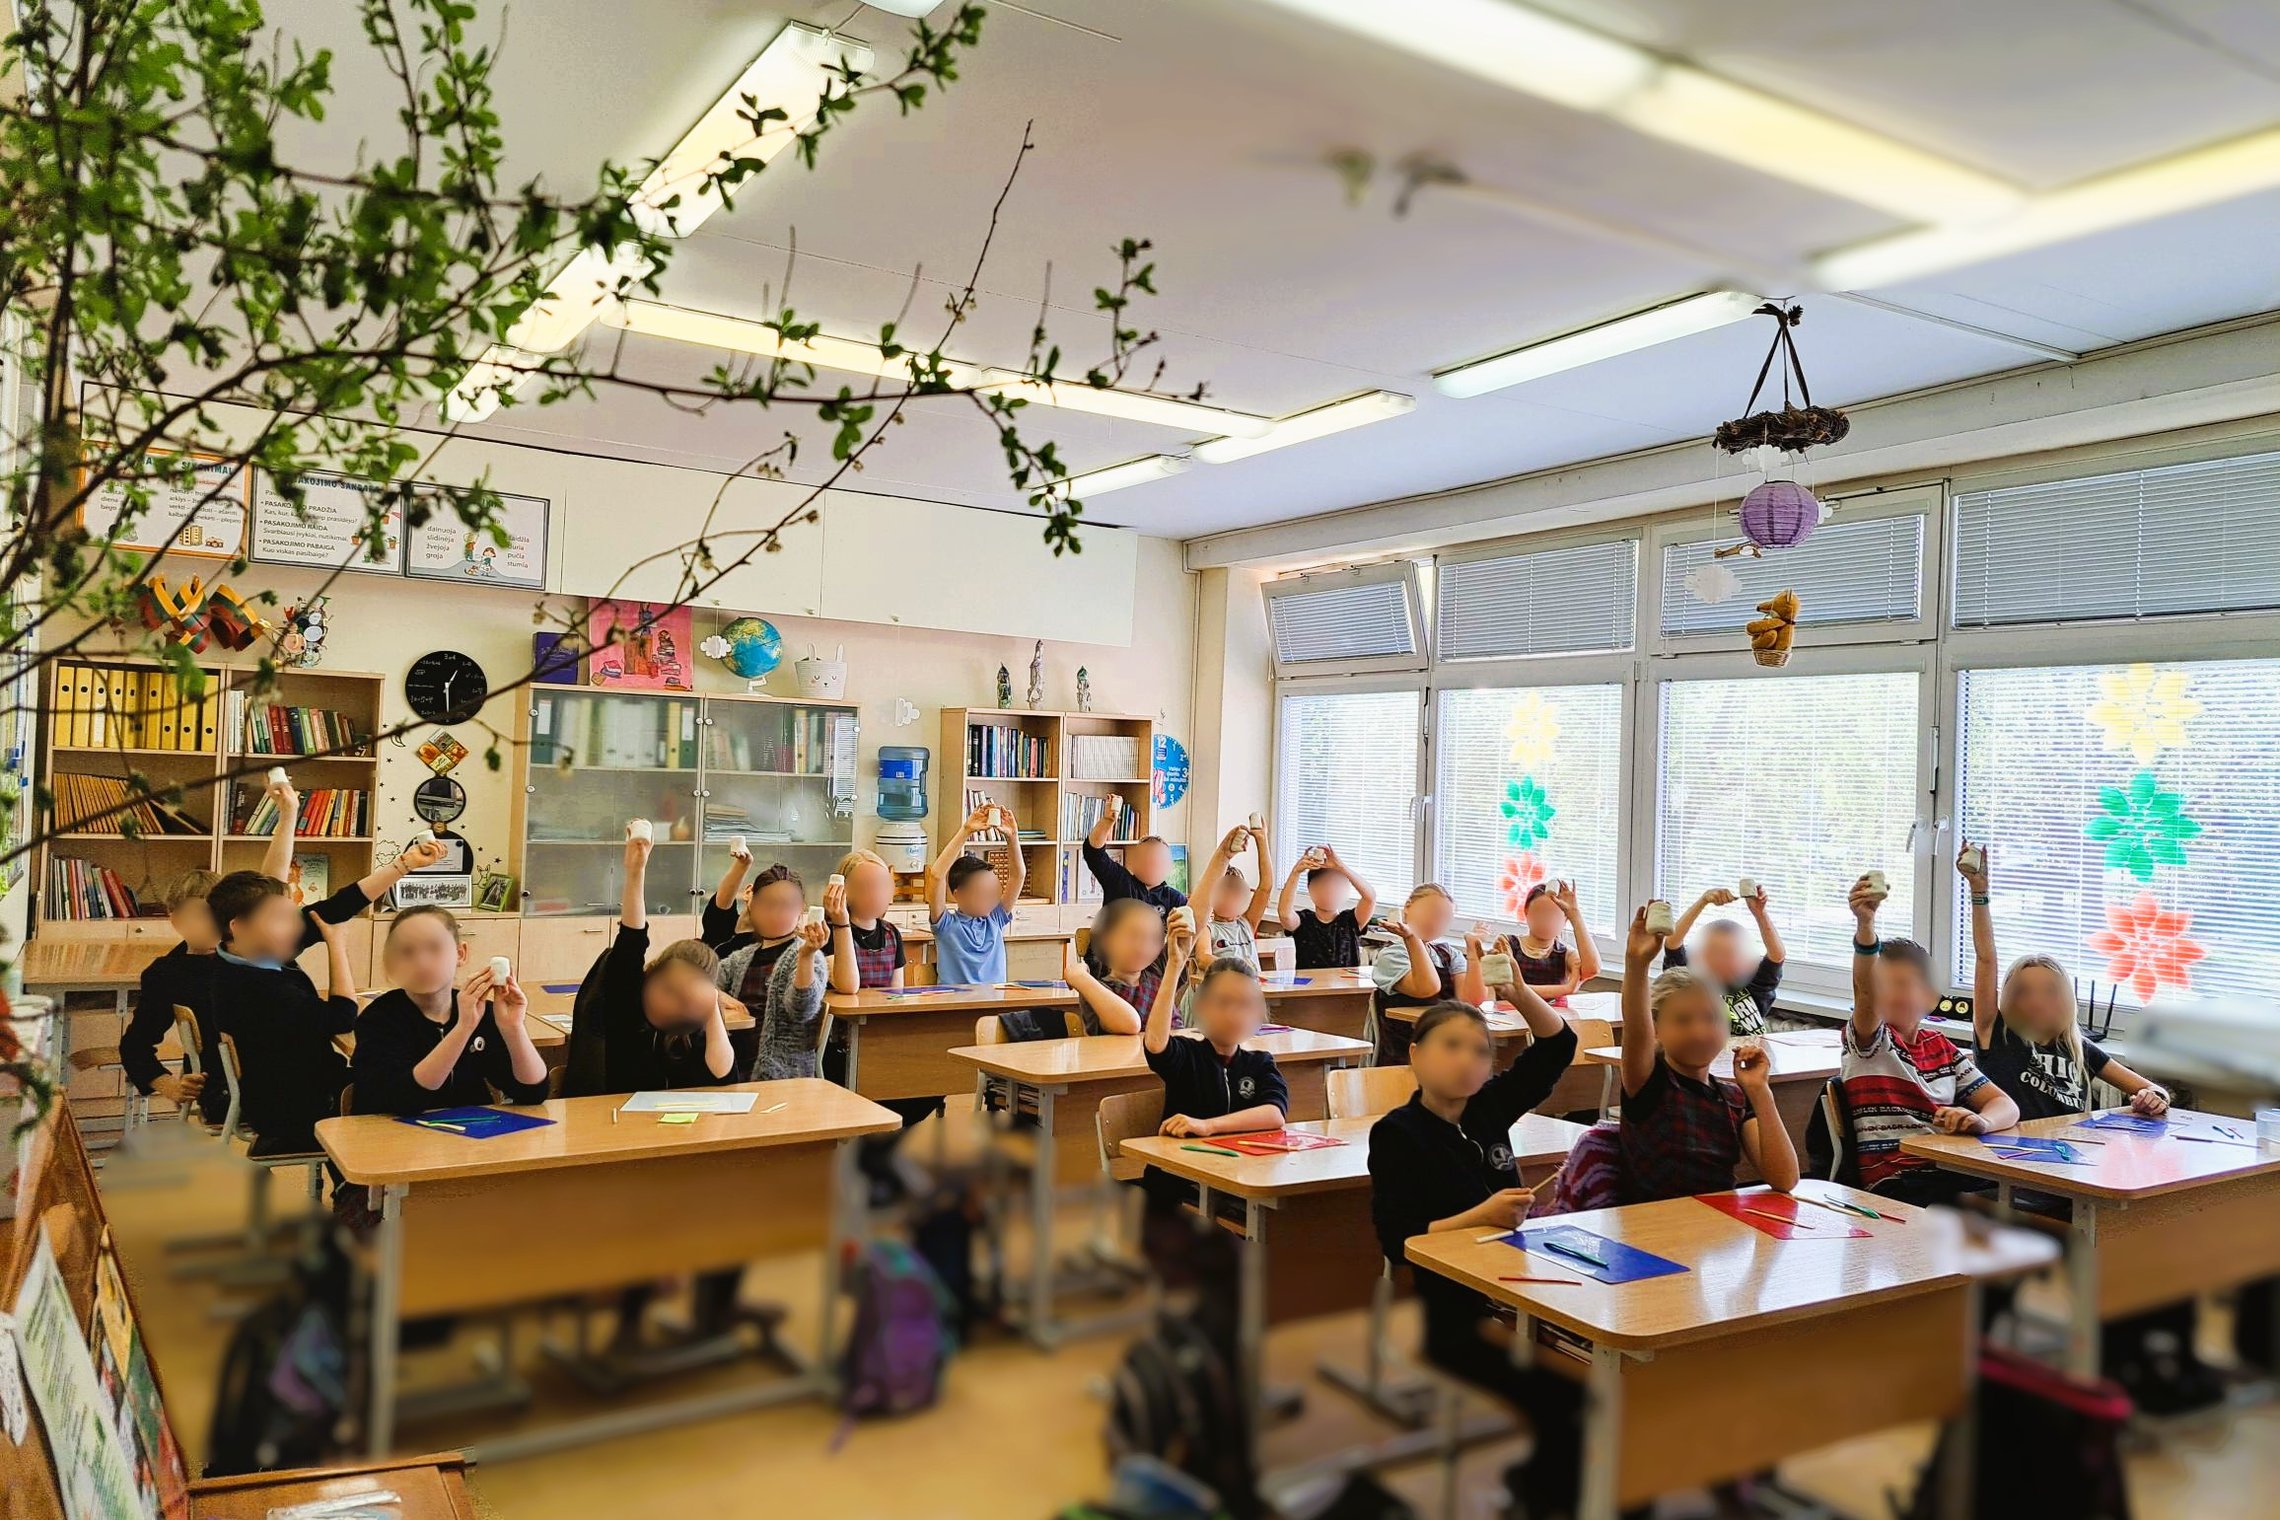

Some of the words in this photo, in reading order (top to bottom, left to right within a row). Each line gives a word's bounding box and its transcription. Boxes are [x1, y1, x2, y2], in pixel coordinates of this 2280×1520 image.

[263, 519, 306, 529] PASAKOJIMO
[262, 539, 306, 548] PASAKOJIMO
[306, 543, 335, 551] PABAIGA
[425, 552, 444, 560] groja
[1182, 767, 1188, 778] 3
